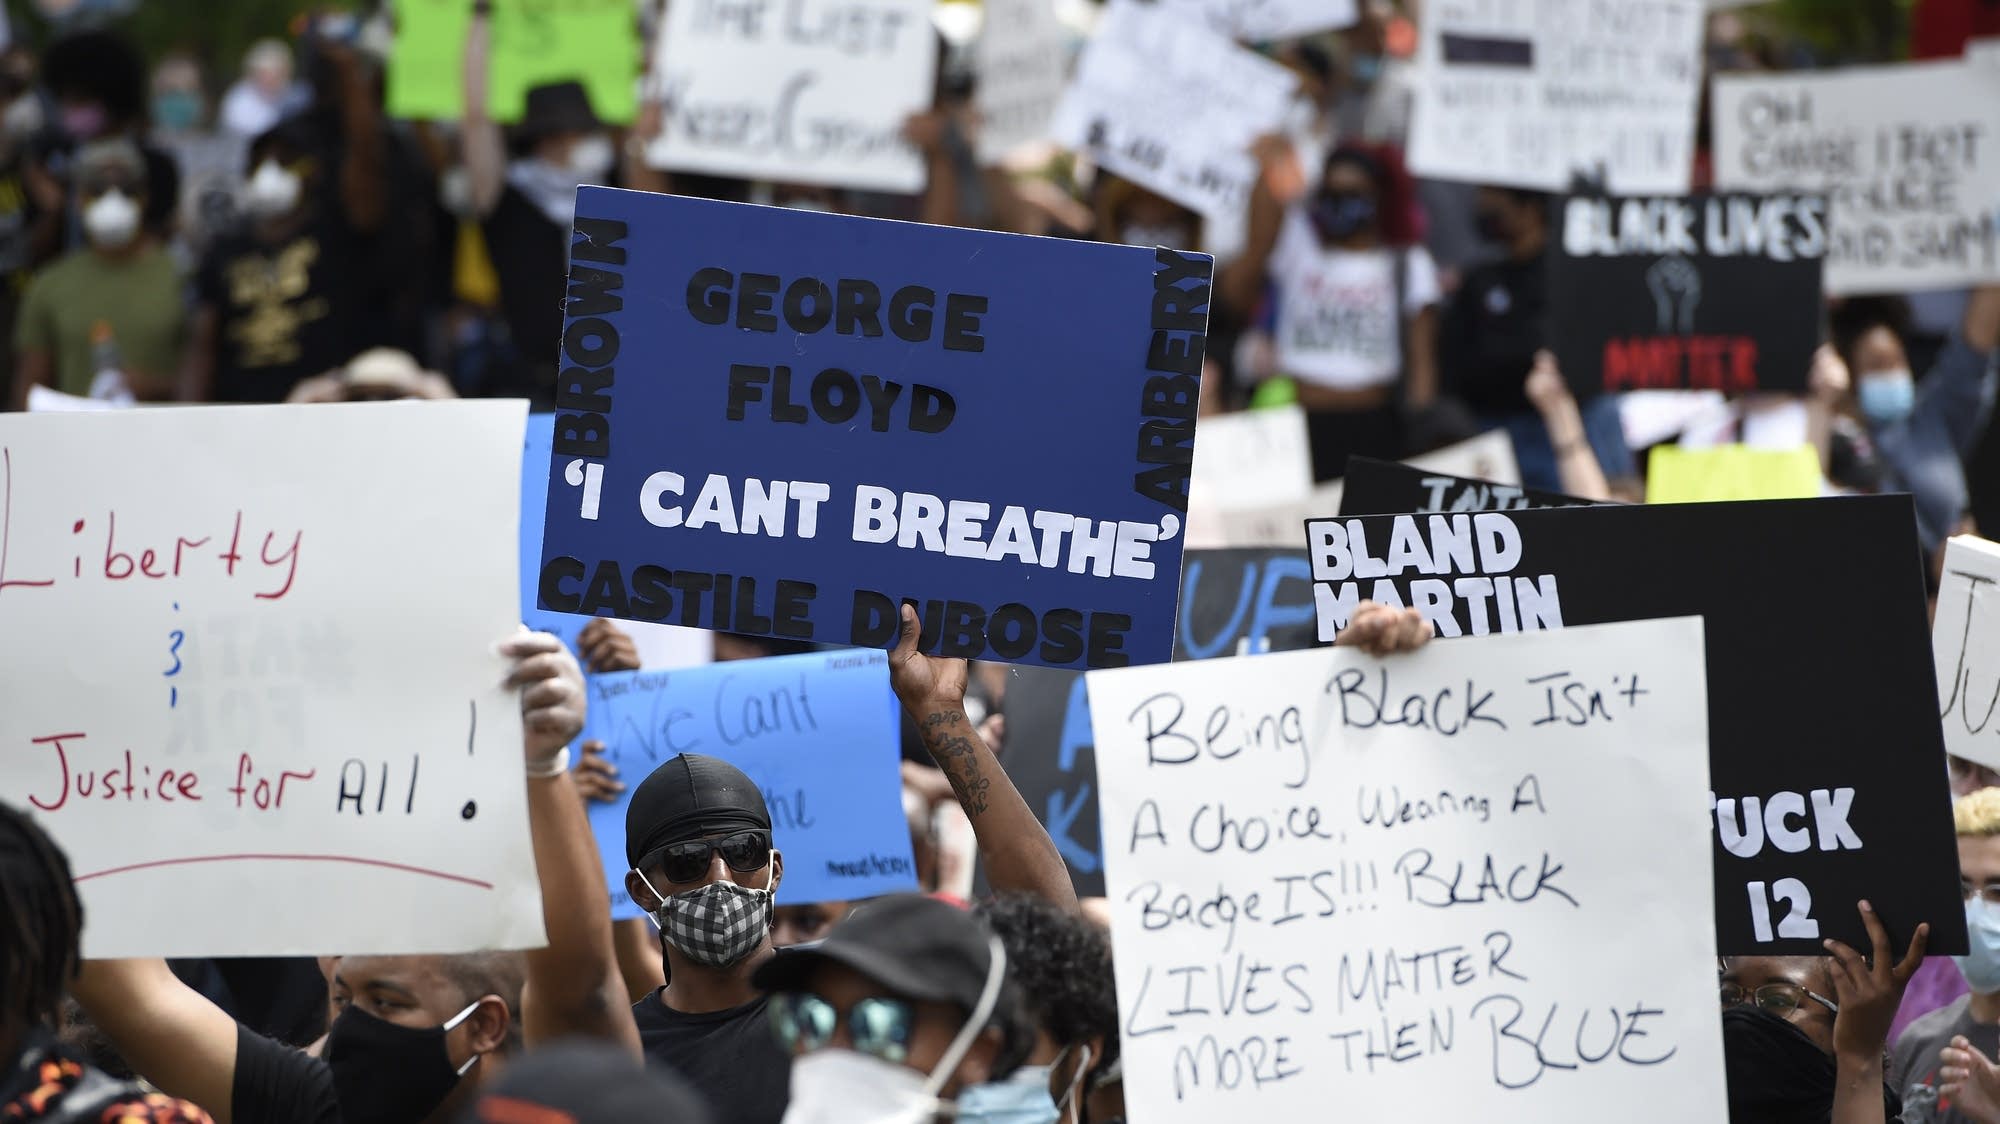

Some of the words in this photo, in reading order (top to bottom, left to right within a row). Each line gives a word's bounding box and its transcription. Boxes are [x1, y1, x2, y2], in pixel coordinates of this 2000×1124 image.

[1564, 196, 1697, 257] BLACK
[1704, 196, 1827, 262] LIVES
[552, 216, 628, 457] BROWN
[686, 267, 989, 354] GEORGE
[726, 364, 957, 434] FLOYD
[1134, 246, 1214, 514] ARBERY
[0, 448, 303, 600] Liberty
[640, 470, 830, 539] CANT
[1308, 513, 1523, 581] BLAND
[540, 556, 817, 639] CASTILE
[28, 732, 202, 811] Justice
[228, 752, 316, 809] for
[1129, 692, 1310, 788] Being
[1130, 798, 1168, 853] A
[1511, 773, 1546, 814] A
[1709, 786, 1863, 858] UCK
[1394, 848, 1580, 908] BLACK
[1747, 877, 1820, 942] 12
[1127, 953, 1313, 1037] LIVES
[1338, 931, 1529, 1014] MATTER
[1174, 1034, 1303, 1102] MORE
[1329, 1003, 1455, 1074] THEN
[1470, 994, 1678, 1090] BLUE
